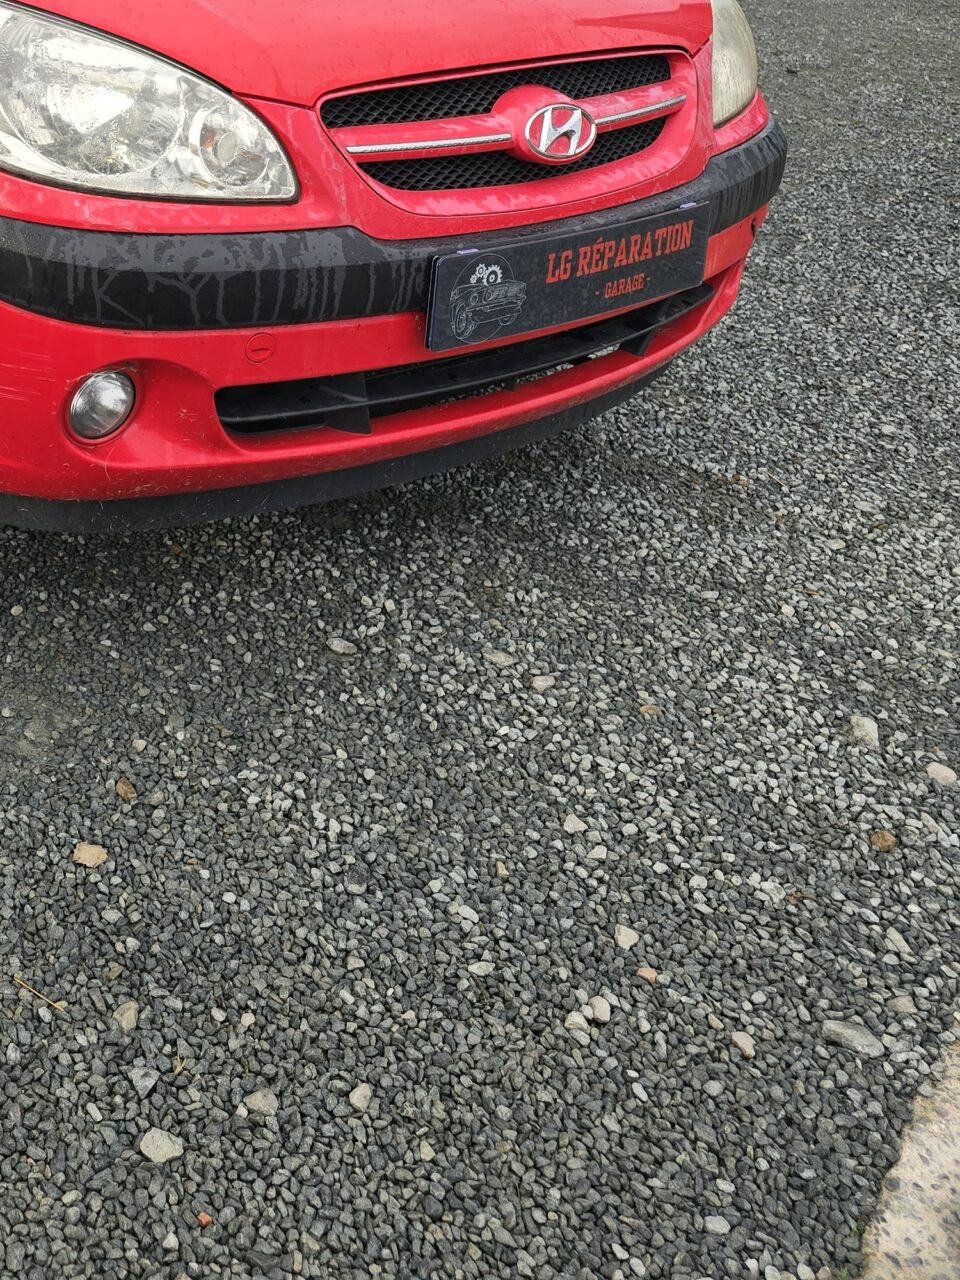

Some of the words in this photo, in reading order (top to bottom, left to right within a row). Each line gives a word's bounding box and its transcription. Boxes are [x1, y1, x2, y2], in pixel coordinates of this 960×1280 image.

[545, 249, 572, 283] LG
[576, 220, 694, 277] RÉPARATION
[604, 273, 644, 299] GARAGE
